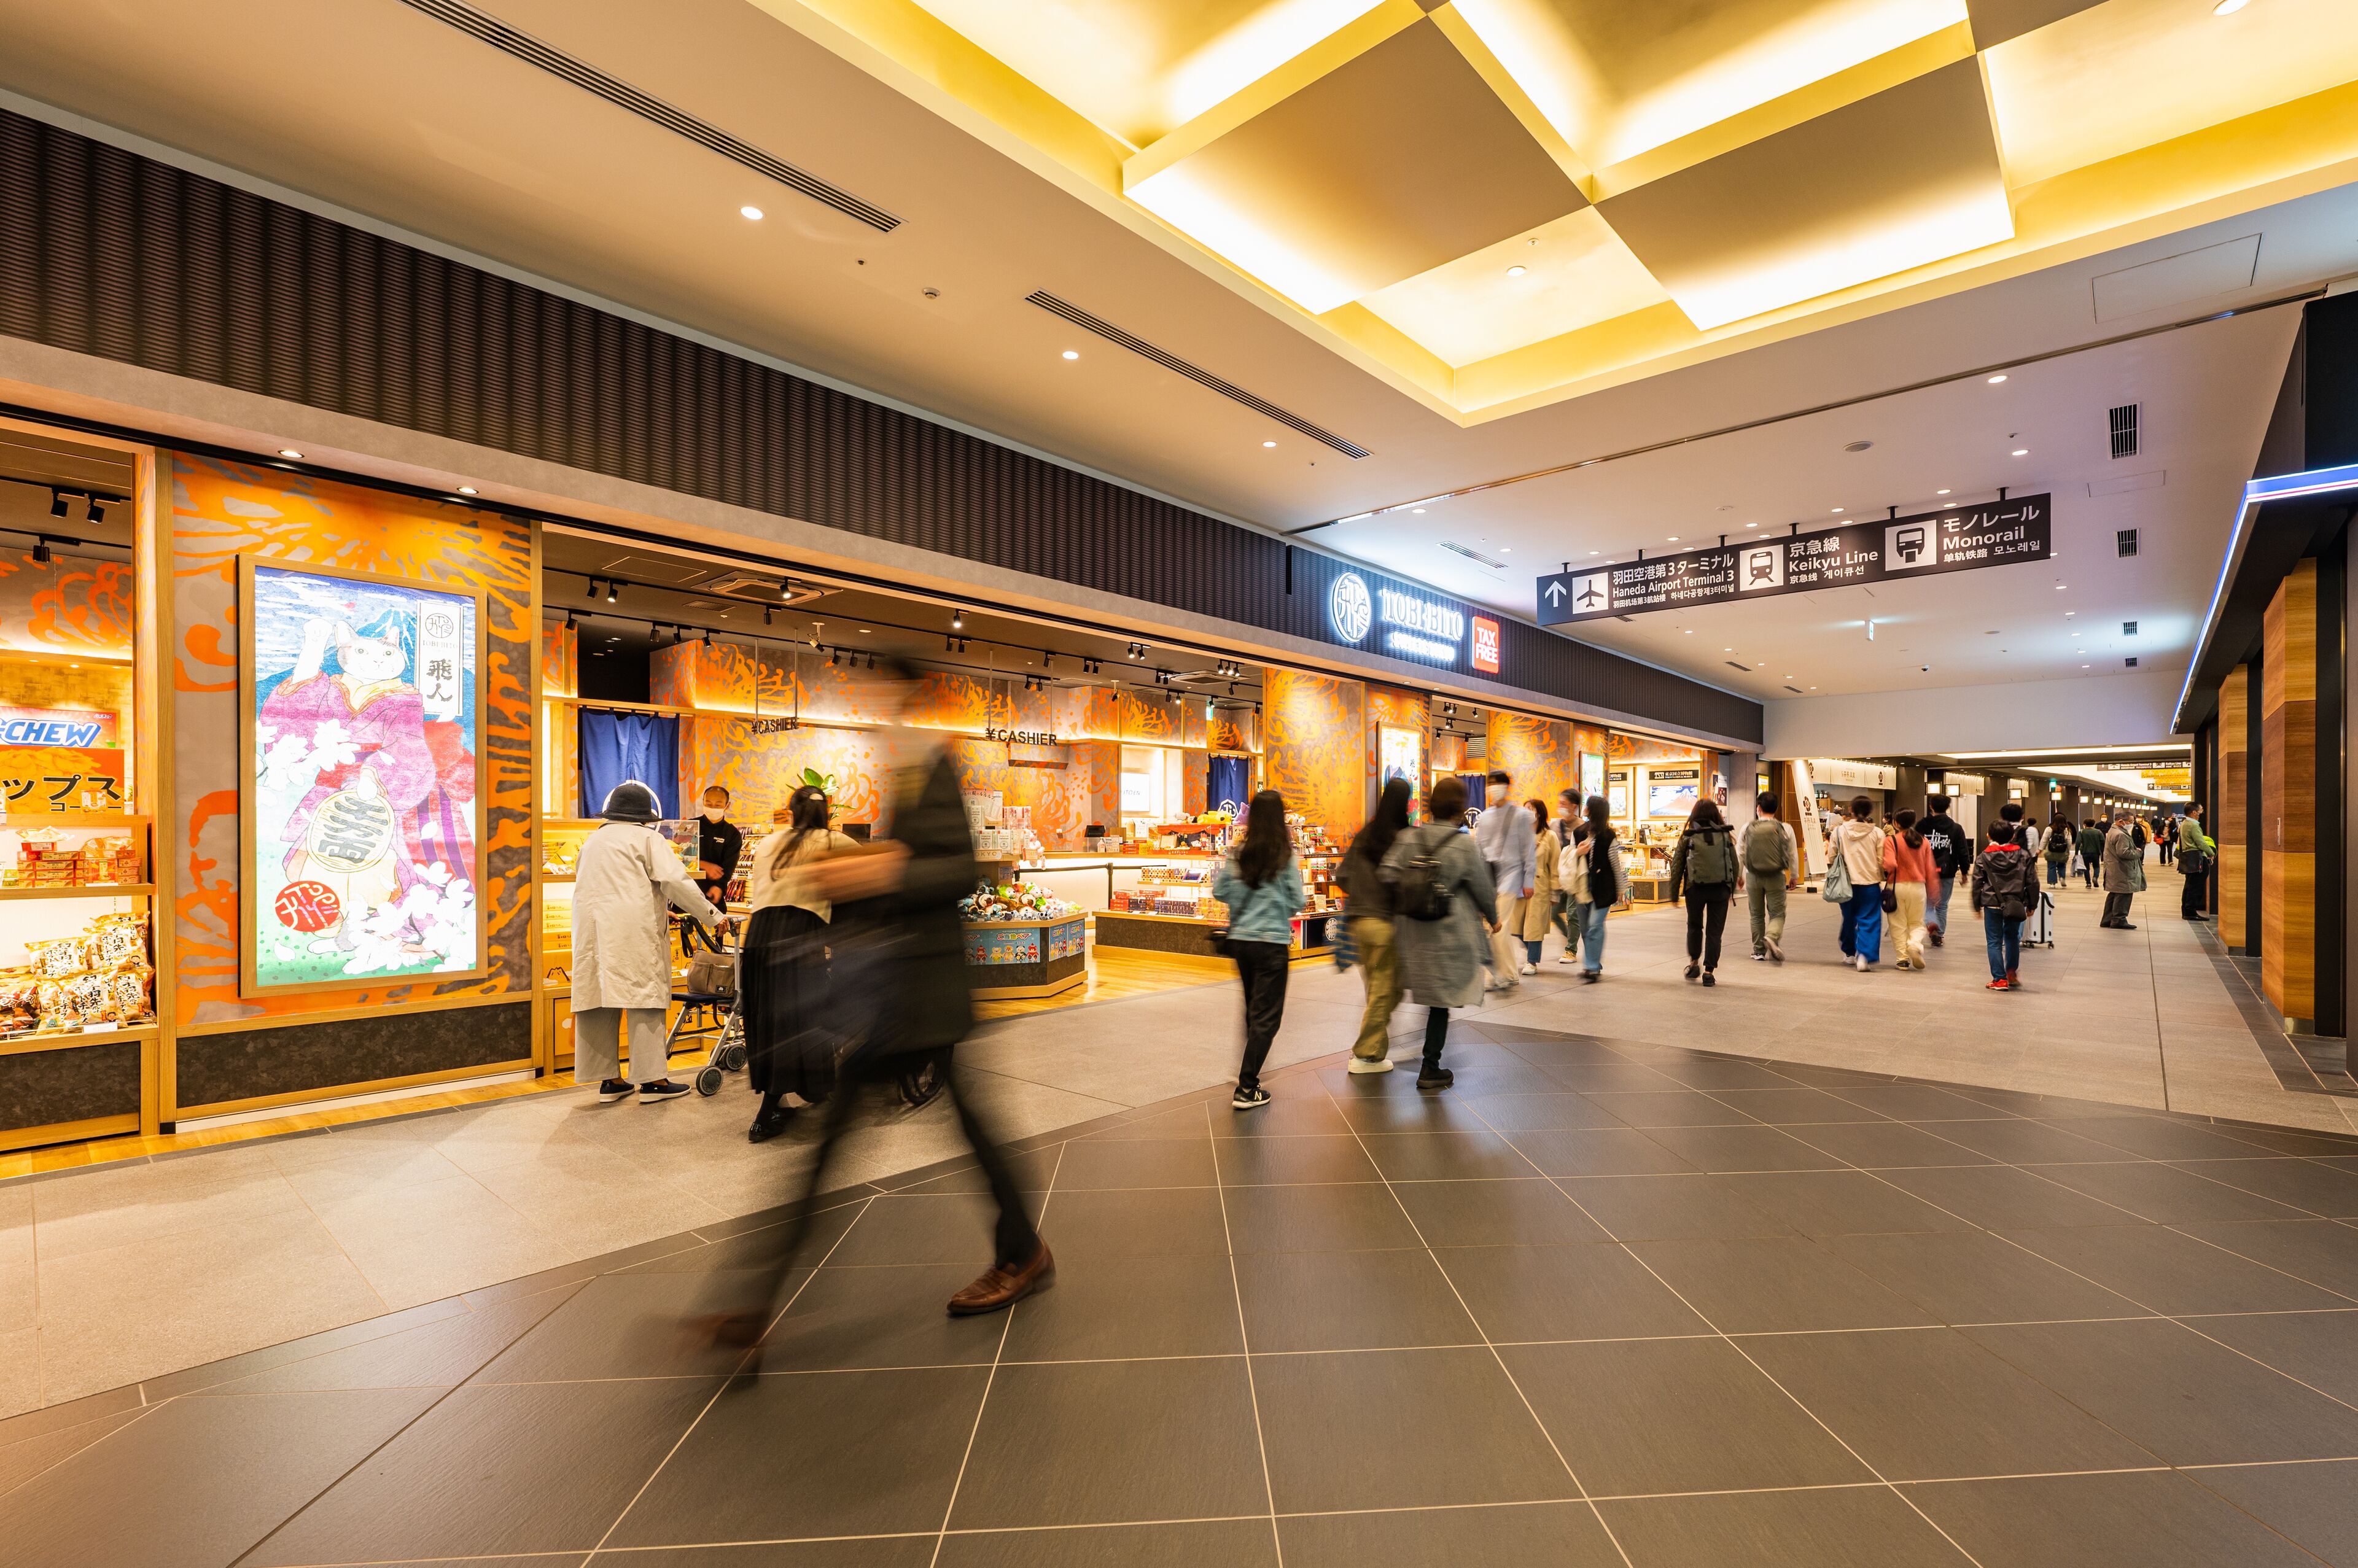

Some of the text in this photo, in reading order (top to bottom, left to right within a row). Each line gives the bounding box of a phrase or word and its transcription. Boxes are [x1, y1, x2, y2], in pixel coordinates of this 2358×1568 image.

[1944, 505, 2040, 532] モノレール
[1789, 536, 1840, 557] 京急線
[1944, 526, 2024, 550] Monorail
[1789, 551, 1878, 572] Keikyu Line
[1944, 540, 2040, 562] 单轨铁路 모노레일
[1613, 570, 1734, 598] Haneda Airport Terminal 3
[1789, 565, 1864, 584] 京急线 게이큐선
[1613, 583, 1734, 608] 羽田机场第3航站楼 하네다공항제3터미널
[1477, 627, 1495, 646] TAX
[1476, 646, 1498, 664] FREE
[50, 802, 122, 812] コーー
